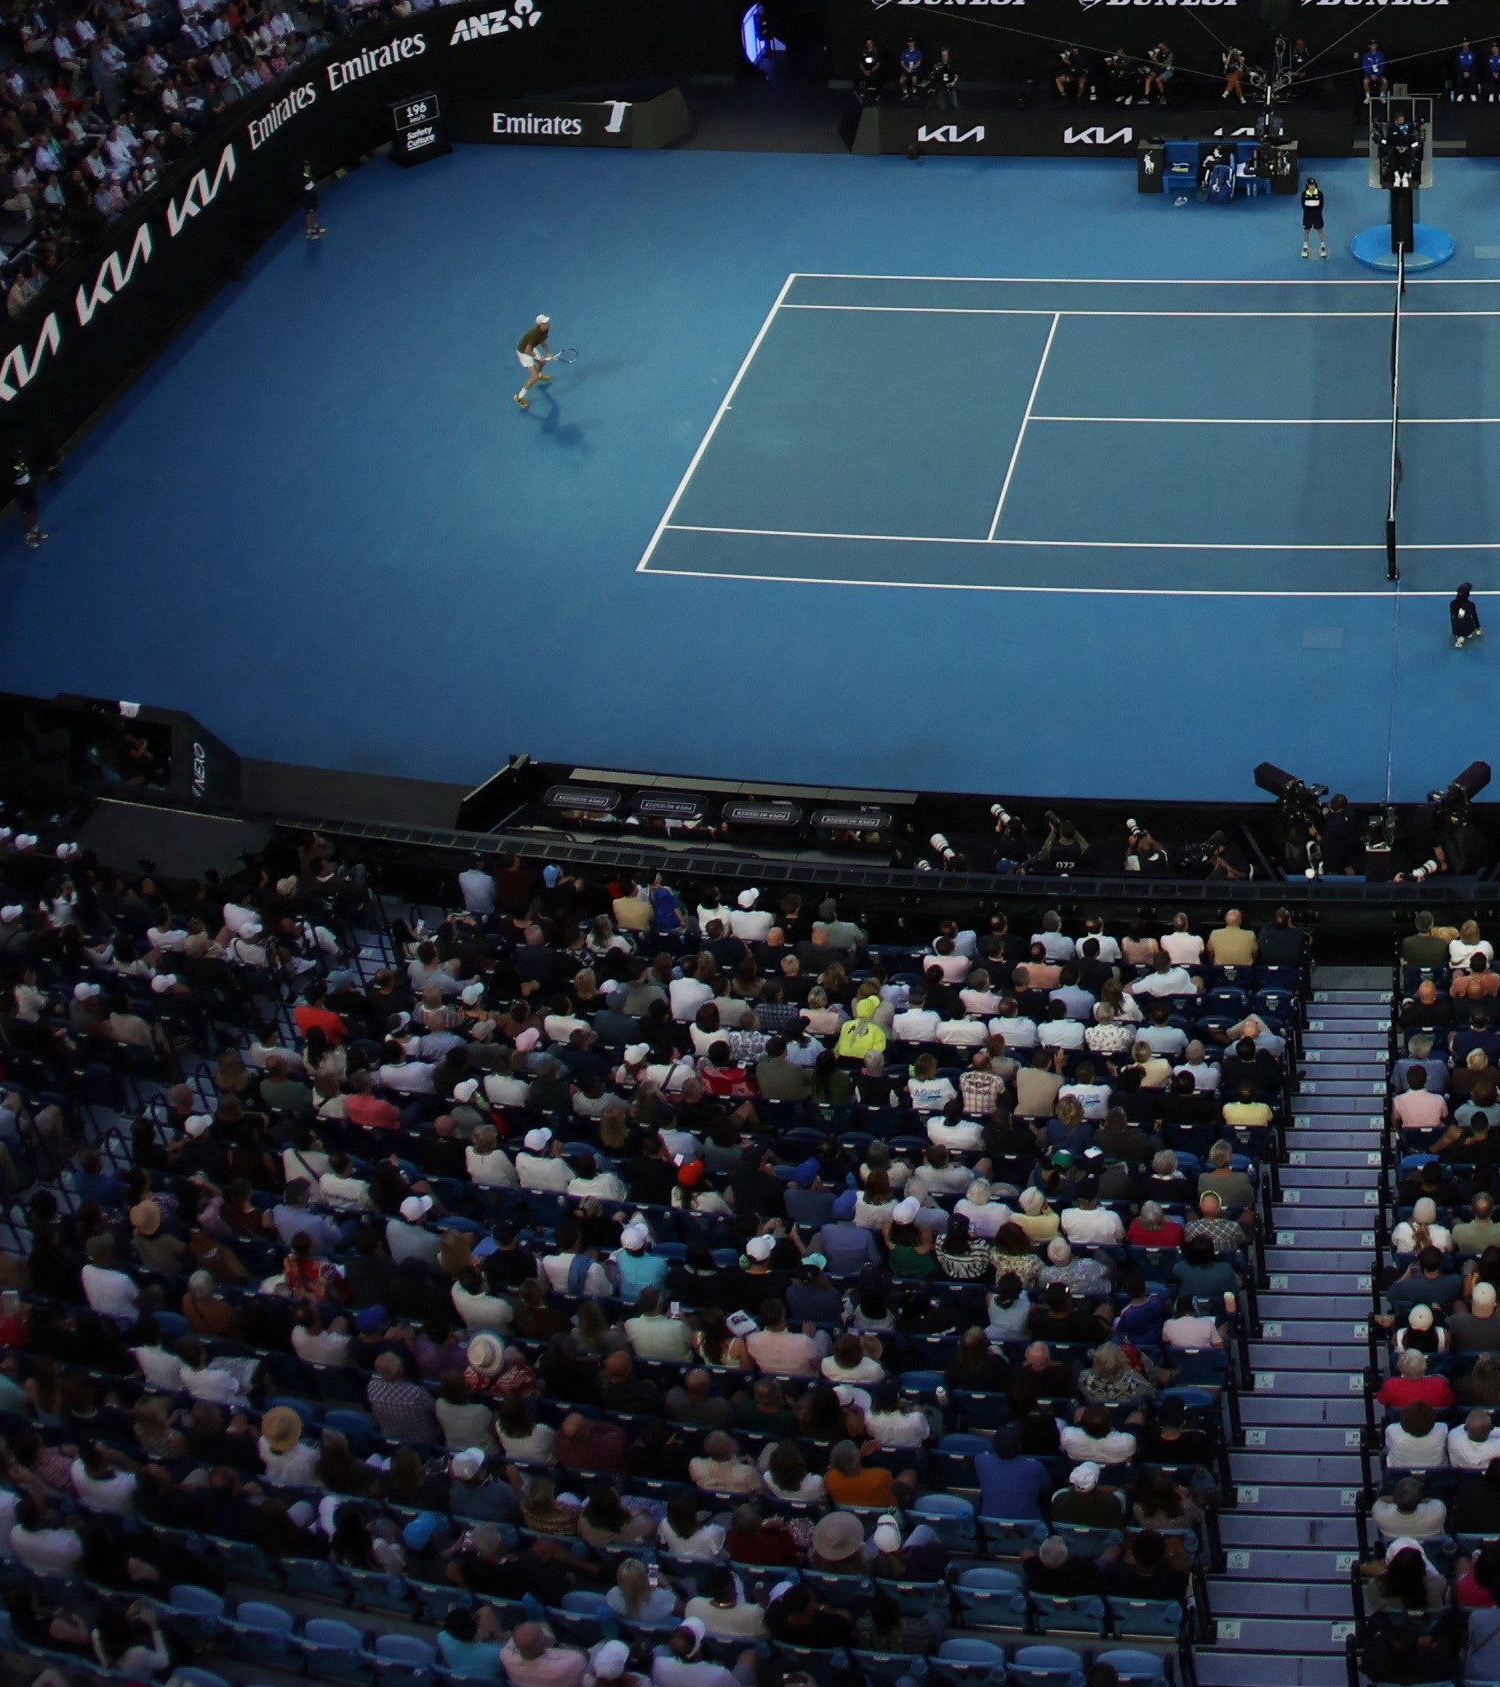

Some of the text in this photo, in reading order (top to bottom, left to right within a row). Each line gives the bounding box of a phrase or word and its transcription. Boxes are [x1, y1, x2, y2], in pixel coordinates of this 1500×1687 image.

[449, 9, 512, 45] ANZ
[326, 33, 426, 91] Emirates
[247, 79, 317, 151] Emirates
[407, 102, 427, 117] 196
[492, 112, 583, 135] Emirates
[917, 125, 1132, 144] KIA KIA
[167, 143, 236, 237] KIA
[75, 222, 152, 327] KIA
